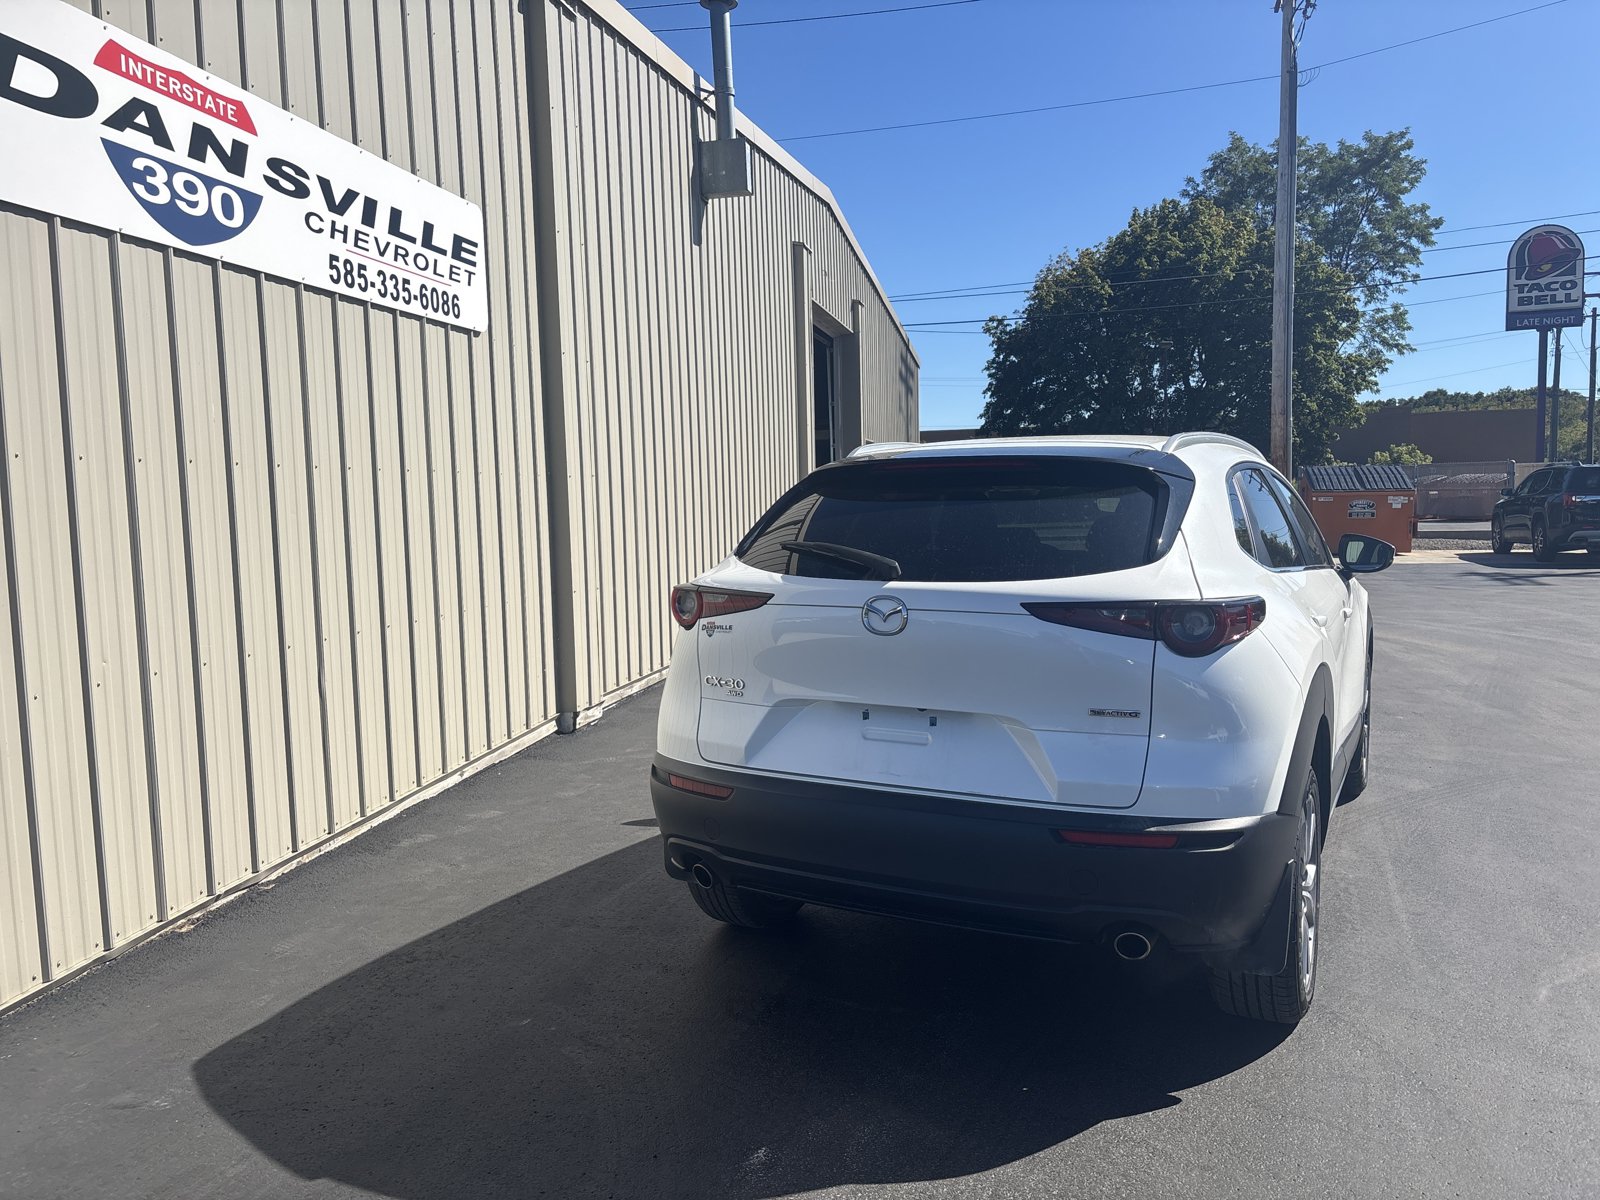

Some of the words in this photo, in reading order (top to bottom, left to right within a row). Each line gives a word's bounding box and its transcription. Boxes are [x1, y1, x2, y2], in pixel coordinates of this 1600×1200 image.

[120, 53, 238, 123] INTERSTATE
[0, 33, 479, 268] DANSVILLE
[131, 156, 245, 229] 390
[304, 211, 477, 287] CHEVROLET
[328, 254, 461, 320] 585-335-6086
[1514, 280, 1578, 294] TACO
[1517, 293, 1579, 306] BELL
[1516, 318, 1540, 327] LATE
[1543, 315, 1576, 325] NIGHT
[704, 675, 746, 691] CX-30
